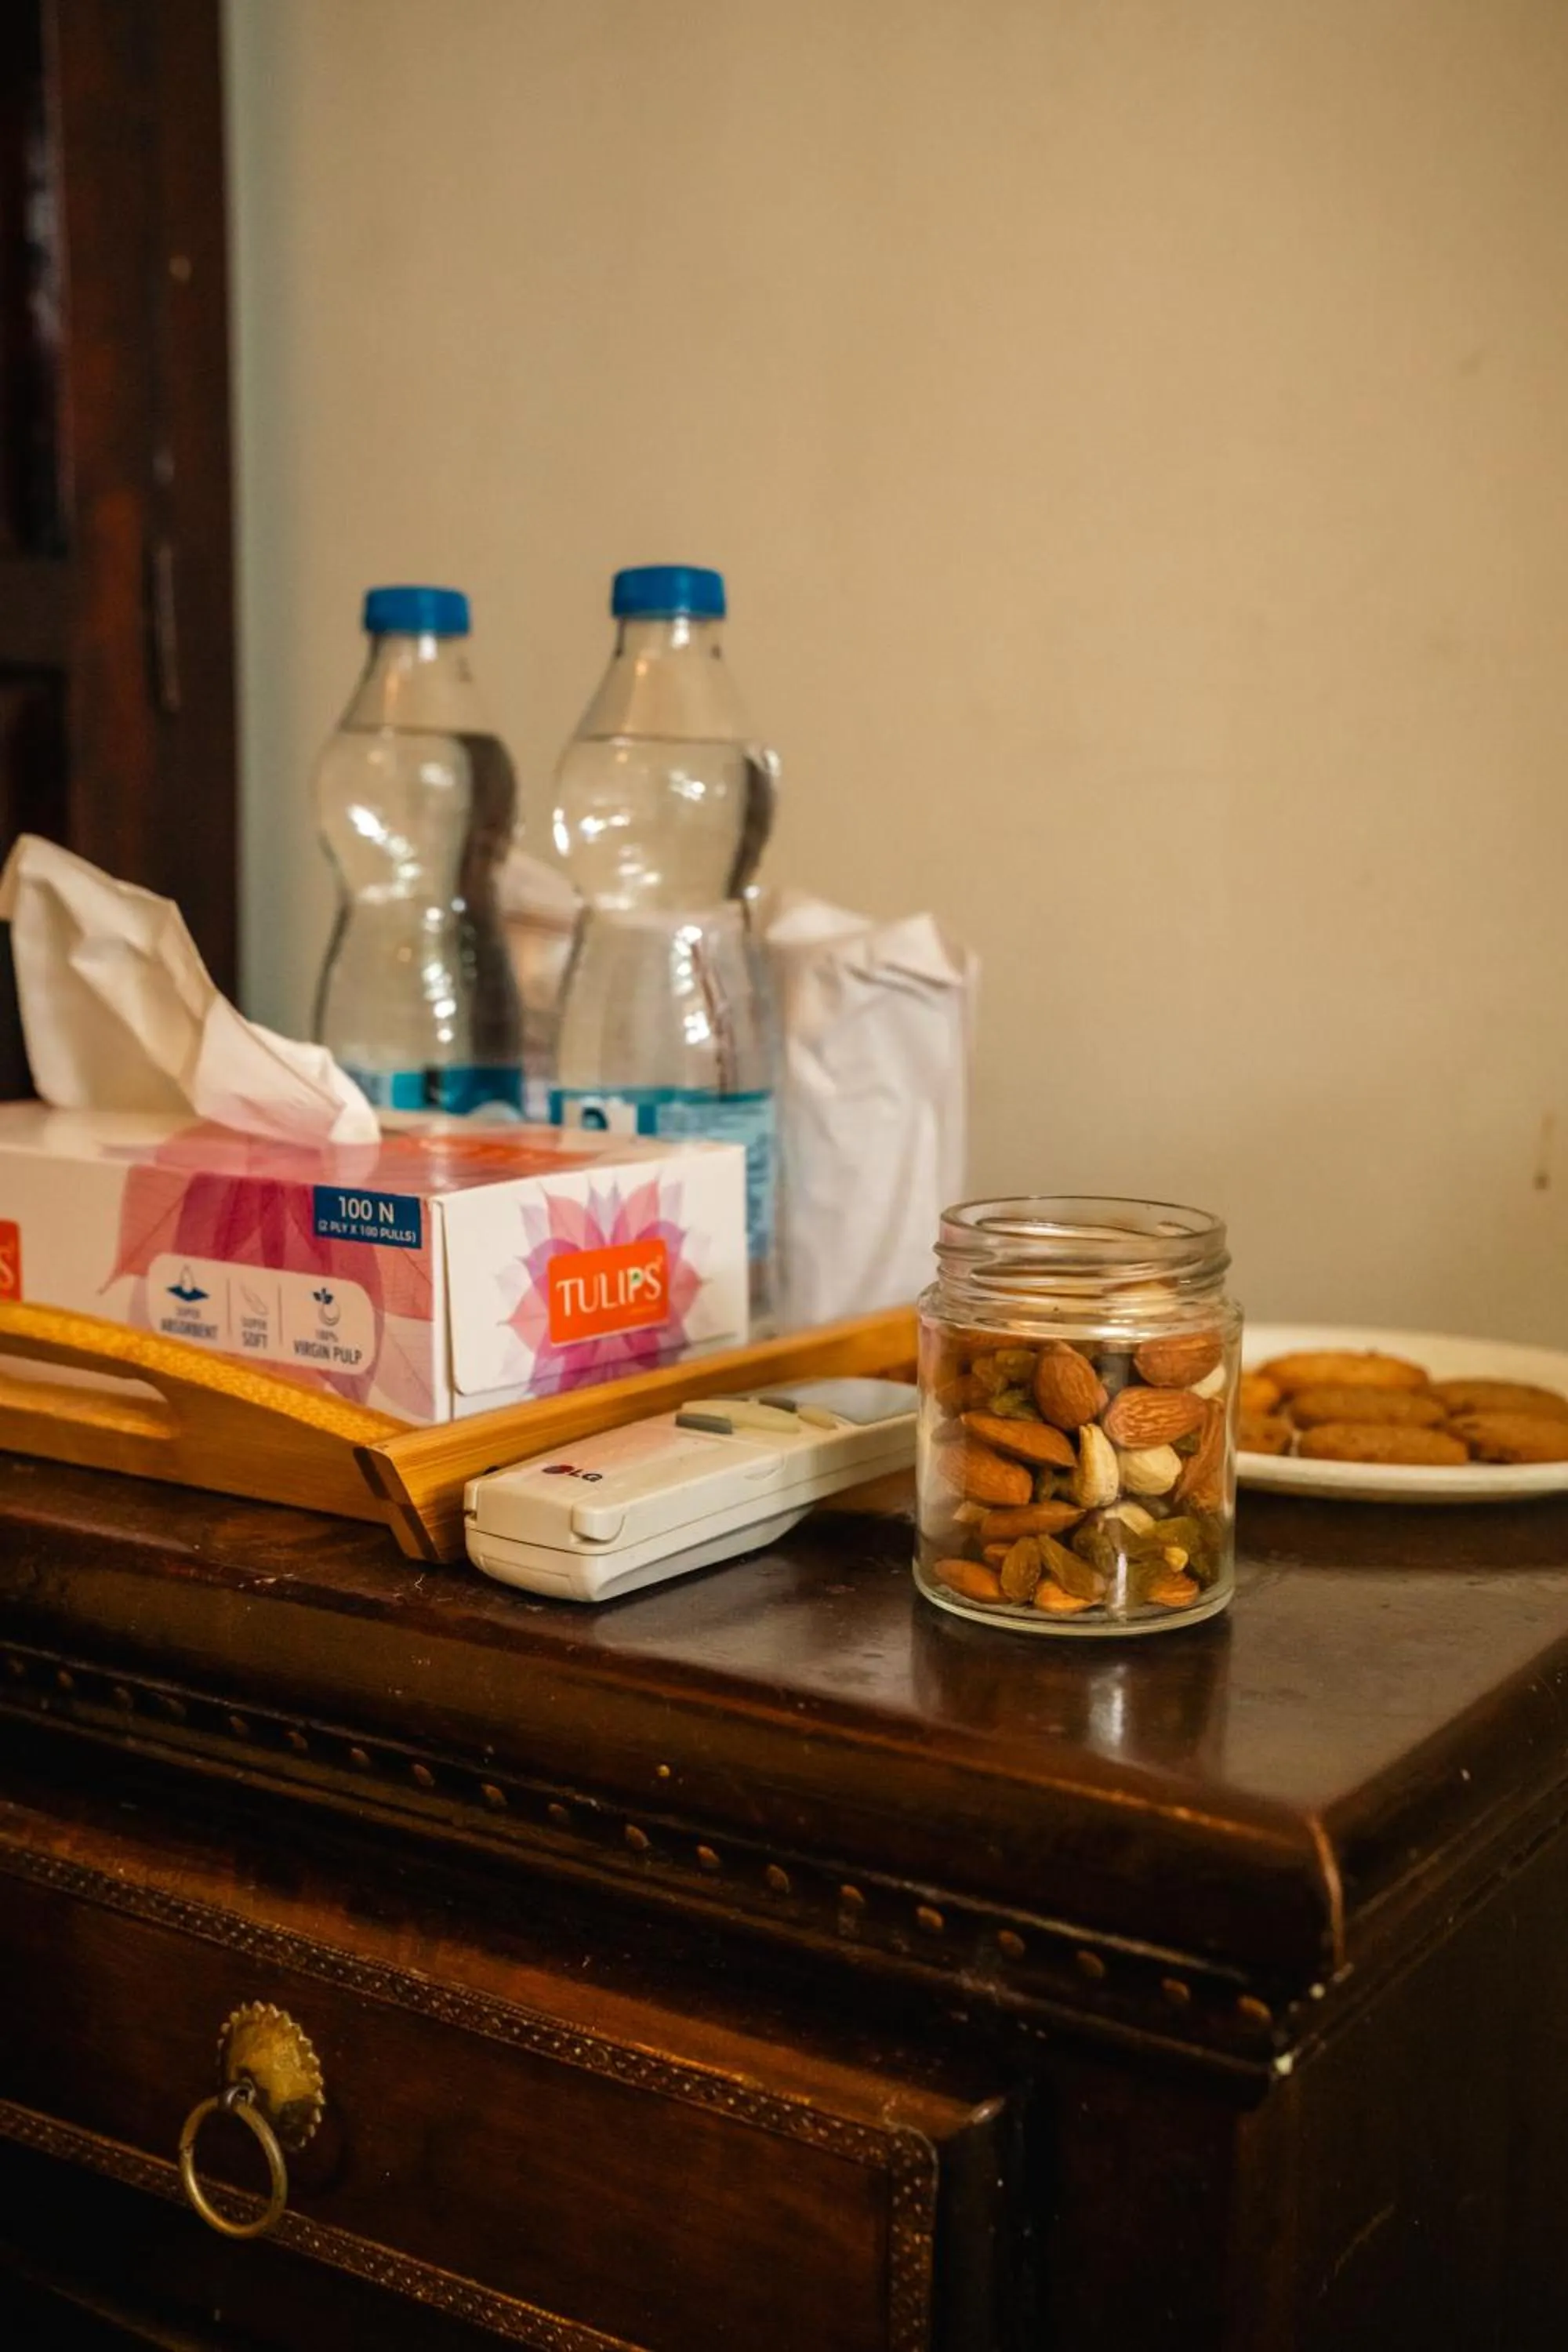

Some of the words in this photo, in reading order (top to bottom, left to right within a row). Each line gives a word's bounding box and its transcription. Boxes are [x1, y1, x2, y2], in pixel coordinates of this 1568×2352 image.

[338, 1195, 373, 1221] 100
[378, 1200, 395, 1225] N
[329, 1220, 348, 1234] PLY
[350, 1223, 358, 1236] X
[360, 1224, 379, 1238] 100
[379, 1227, 416, 1243] PULLS)
[555, 1259, 662, 1317] TULIPS
[241, 1330, 268, 1349] SOFT
[292, 1339, 330, 1360] VIRGIN
[333, 1346, 363, 1365] PULP
[568, 1468, 603, 1483] LG
